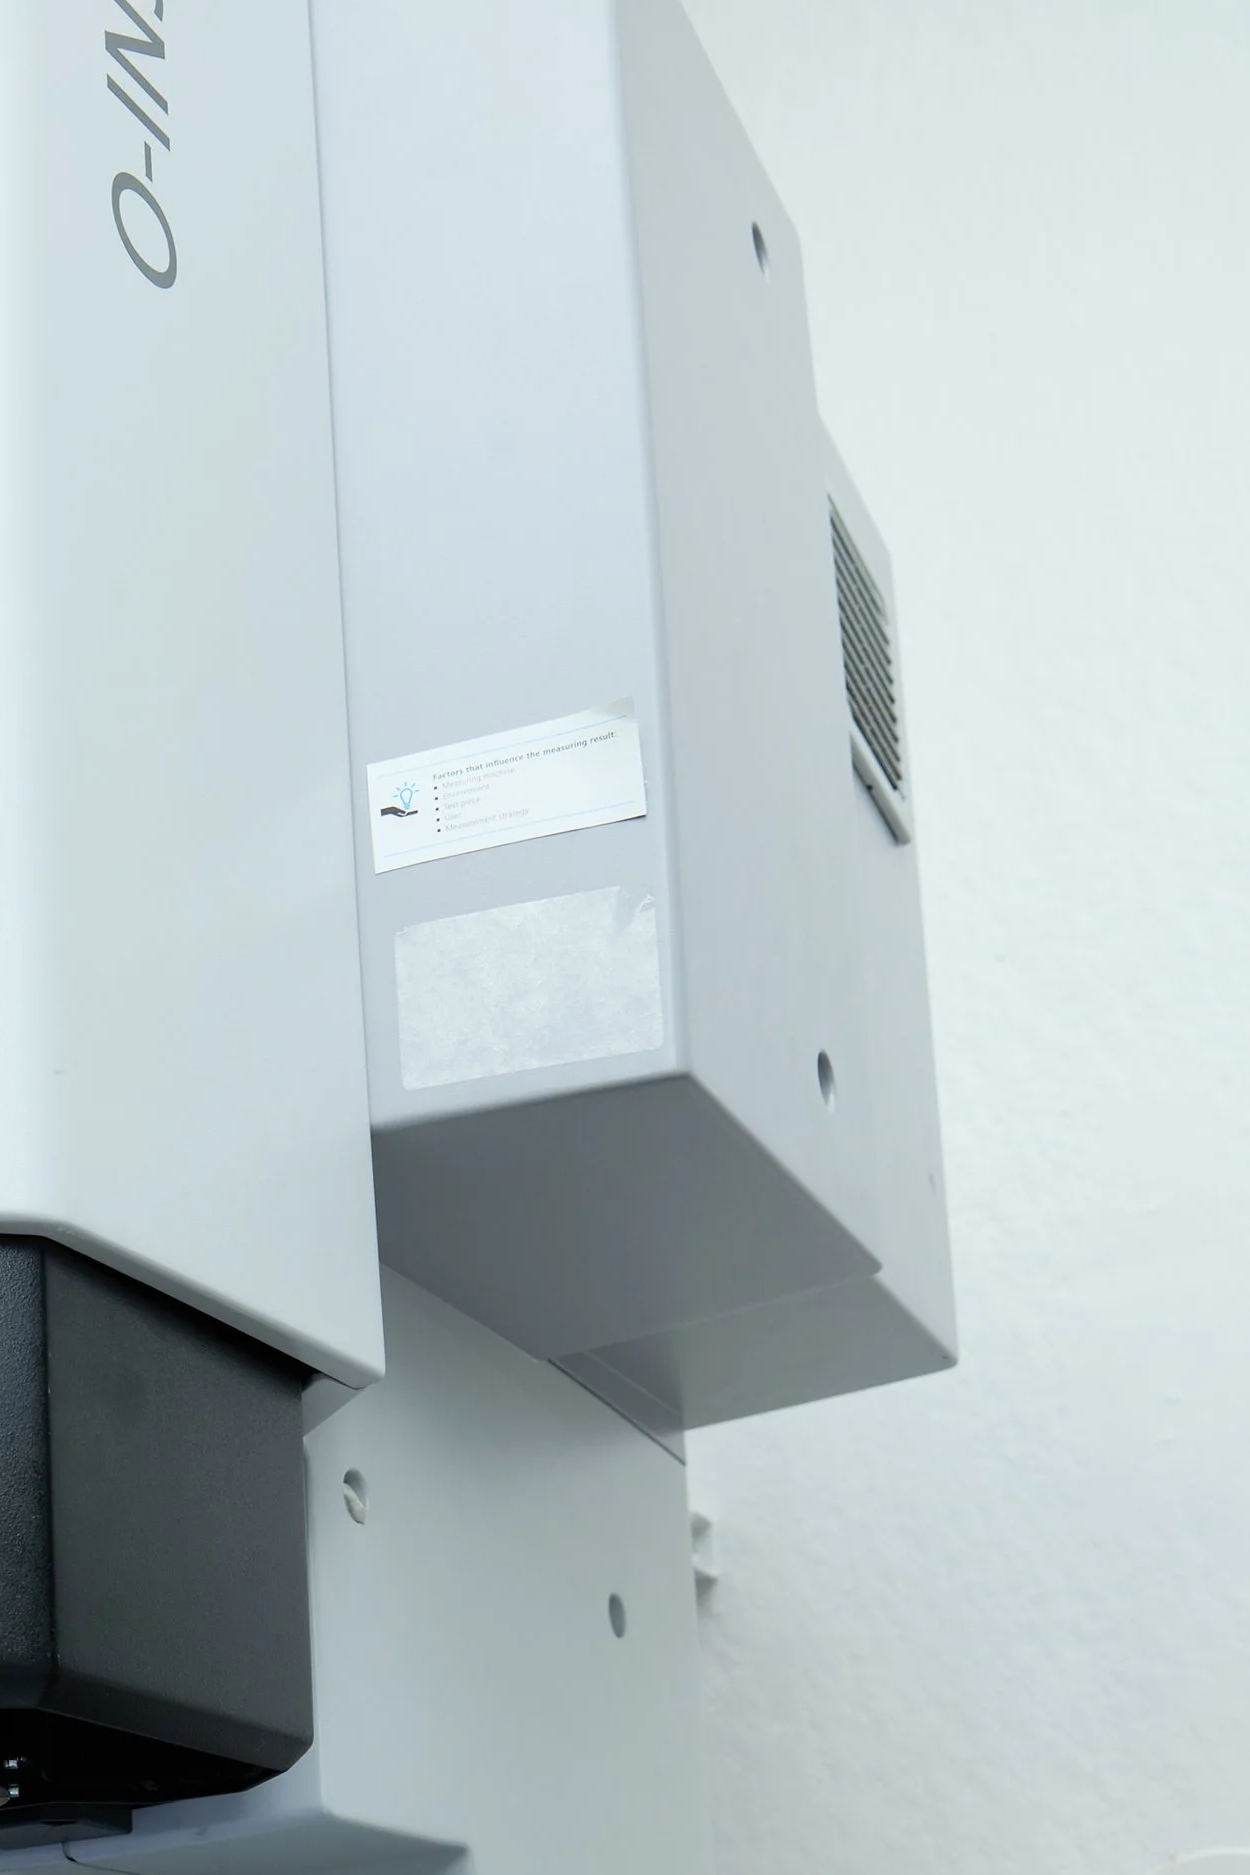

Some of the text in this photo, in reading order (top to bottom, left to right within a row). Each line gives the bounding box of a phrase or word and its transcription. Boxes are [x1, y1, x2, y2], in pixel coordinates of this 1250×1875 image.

[105, 0, 177, 289] O-IN
[433, 767, 463, 780] Factors
[466, 763, 483, 773] that
[485, 754, 524, 768] influence
[526, 750, 541, 759] the
[543, 739, 588, 756] measuring
[442, 767, 515, 790] Measuring machine
[442, 784, 490, 800] Environment
[444, 796, 481, 810] Test piece
[445, 807, 529, 832] Measurement strategy
